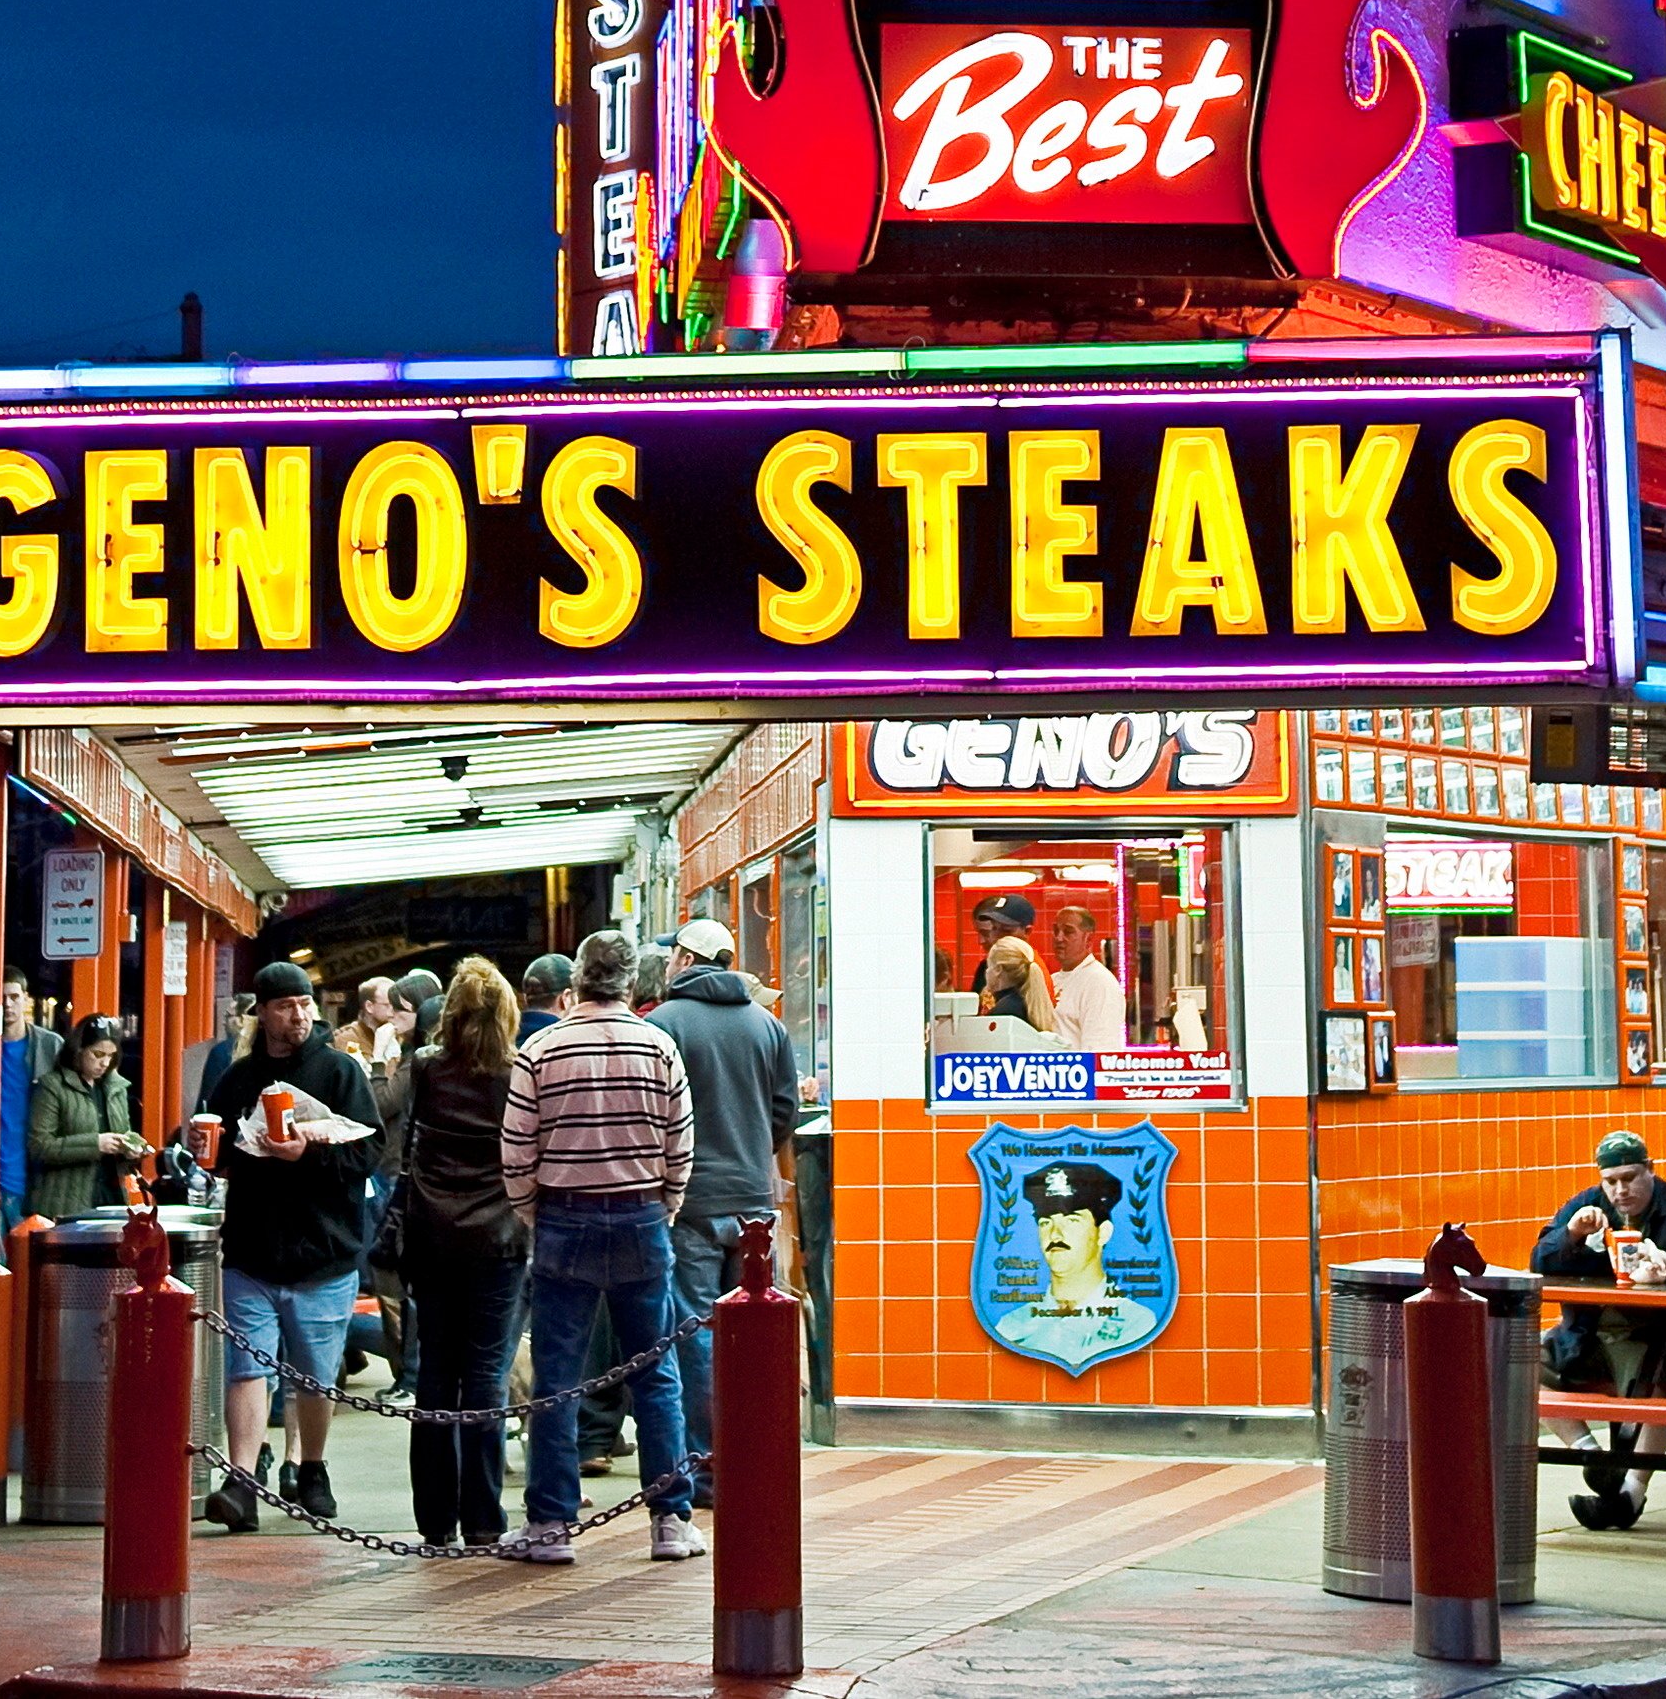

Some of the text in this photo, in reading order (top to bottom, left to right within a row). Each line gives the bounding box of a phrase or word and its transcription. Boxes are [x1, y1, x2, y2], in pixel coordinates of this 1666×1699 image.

[1062, 36, 1163, 81] THE
[892, 31, 1244, 211] Best
[755, 417, 1559, 646] STEAKS
[873, 709, 1257, 789] GENO'S
[53, 856, 95, 873] LOADING
[61, 877, 86, 893] ONLY
[938, 1057, 1088, 1098] JOEY VENTO
[1100, 1051, 1226, 1070] Welcomes You!
